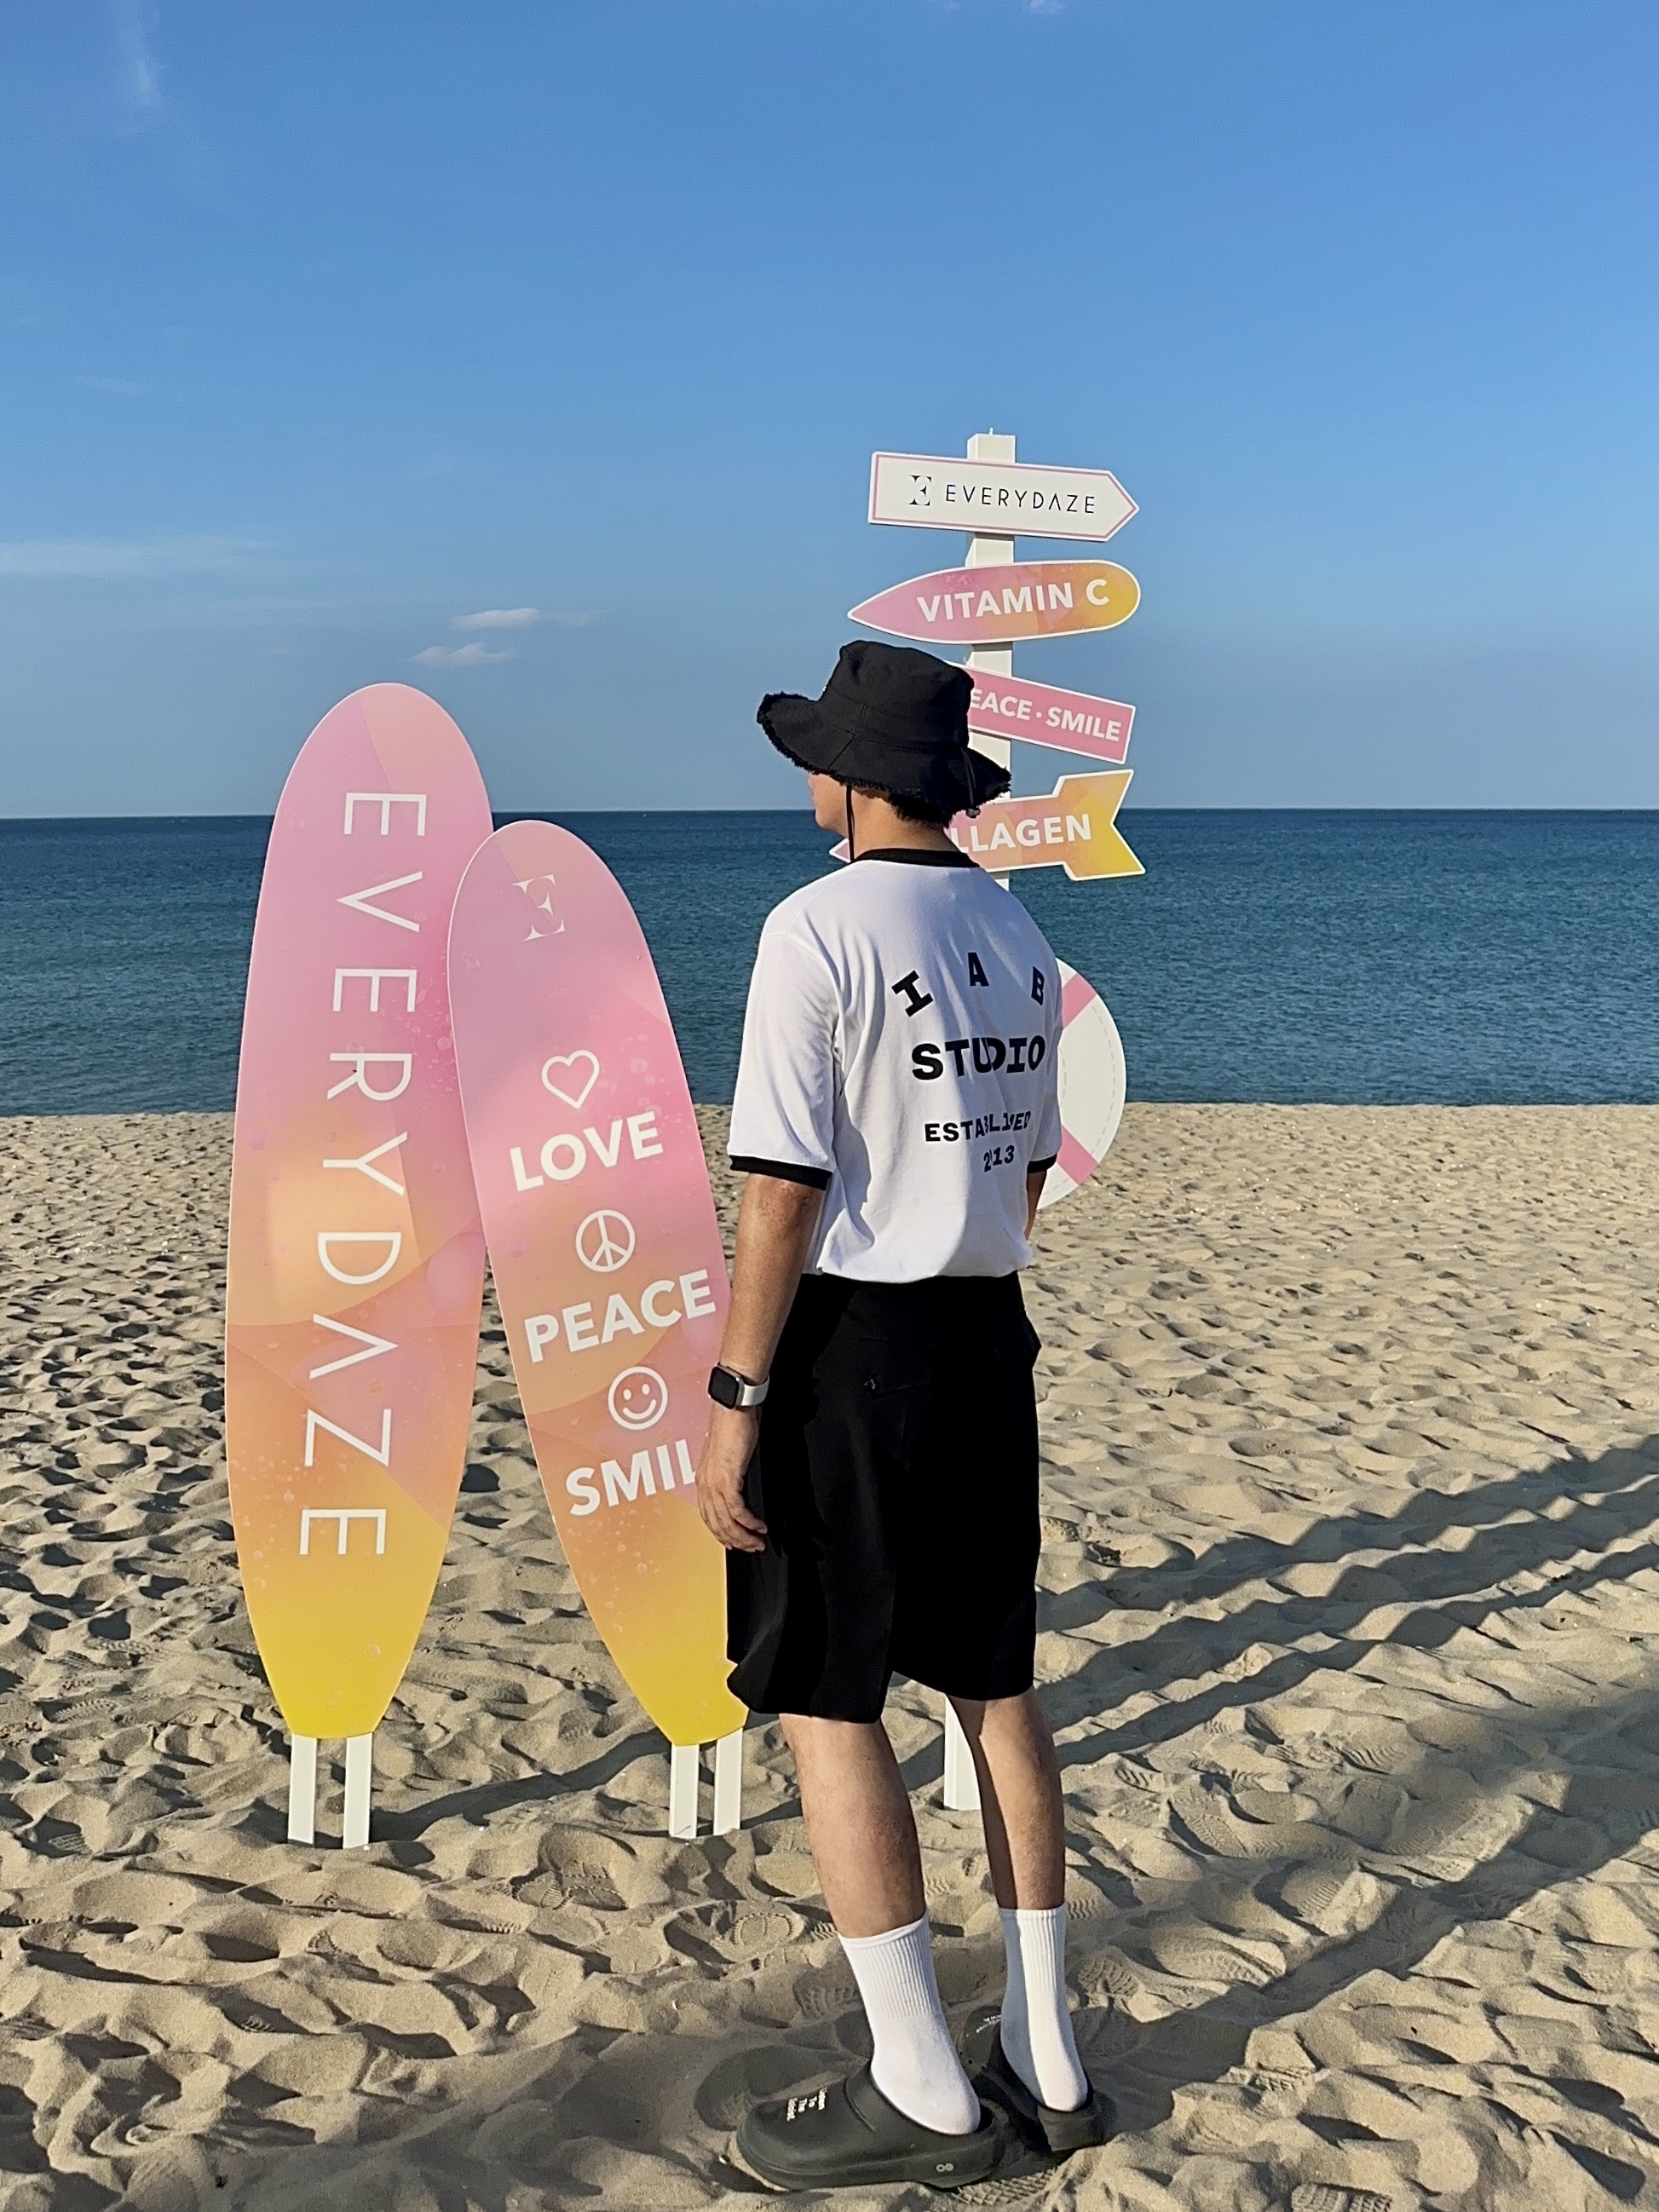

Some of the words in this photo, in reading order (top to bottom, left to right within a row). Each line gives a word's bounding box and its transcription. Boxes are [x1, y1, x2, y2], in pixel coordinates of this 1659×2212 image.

[945, 483, 1096, 514] EVERYDAZE
[916, 582, 1074, 623] VITAMIN
[1086, 579, 1110, 606] C
[970, 688, 1033, 721] EACE
[1045, 706, 1122, 742] SMILE
[950, 814, 1092, 853] LLAGEN
[911, 1034, 1046, 1081] STUDIO
[299, 792, 428, 1556] EVERYDAZE
[510, 1111, 665, 1192] LOVE
[983, 1144, 1015, 1172] 213
[524, 1269, 717, 1363] PEACE
[565, 1438, 697, 1517] SMIL
